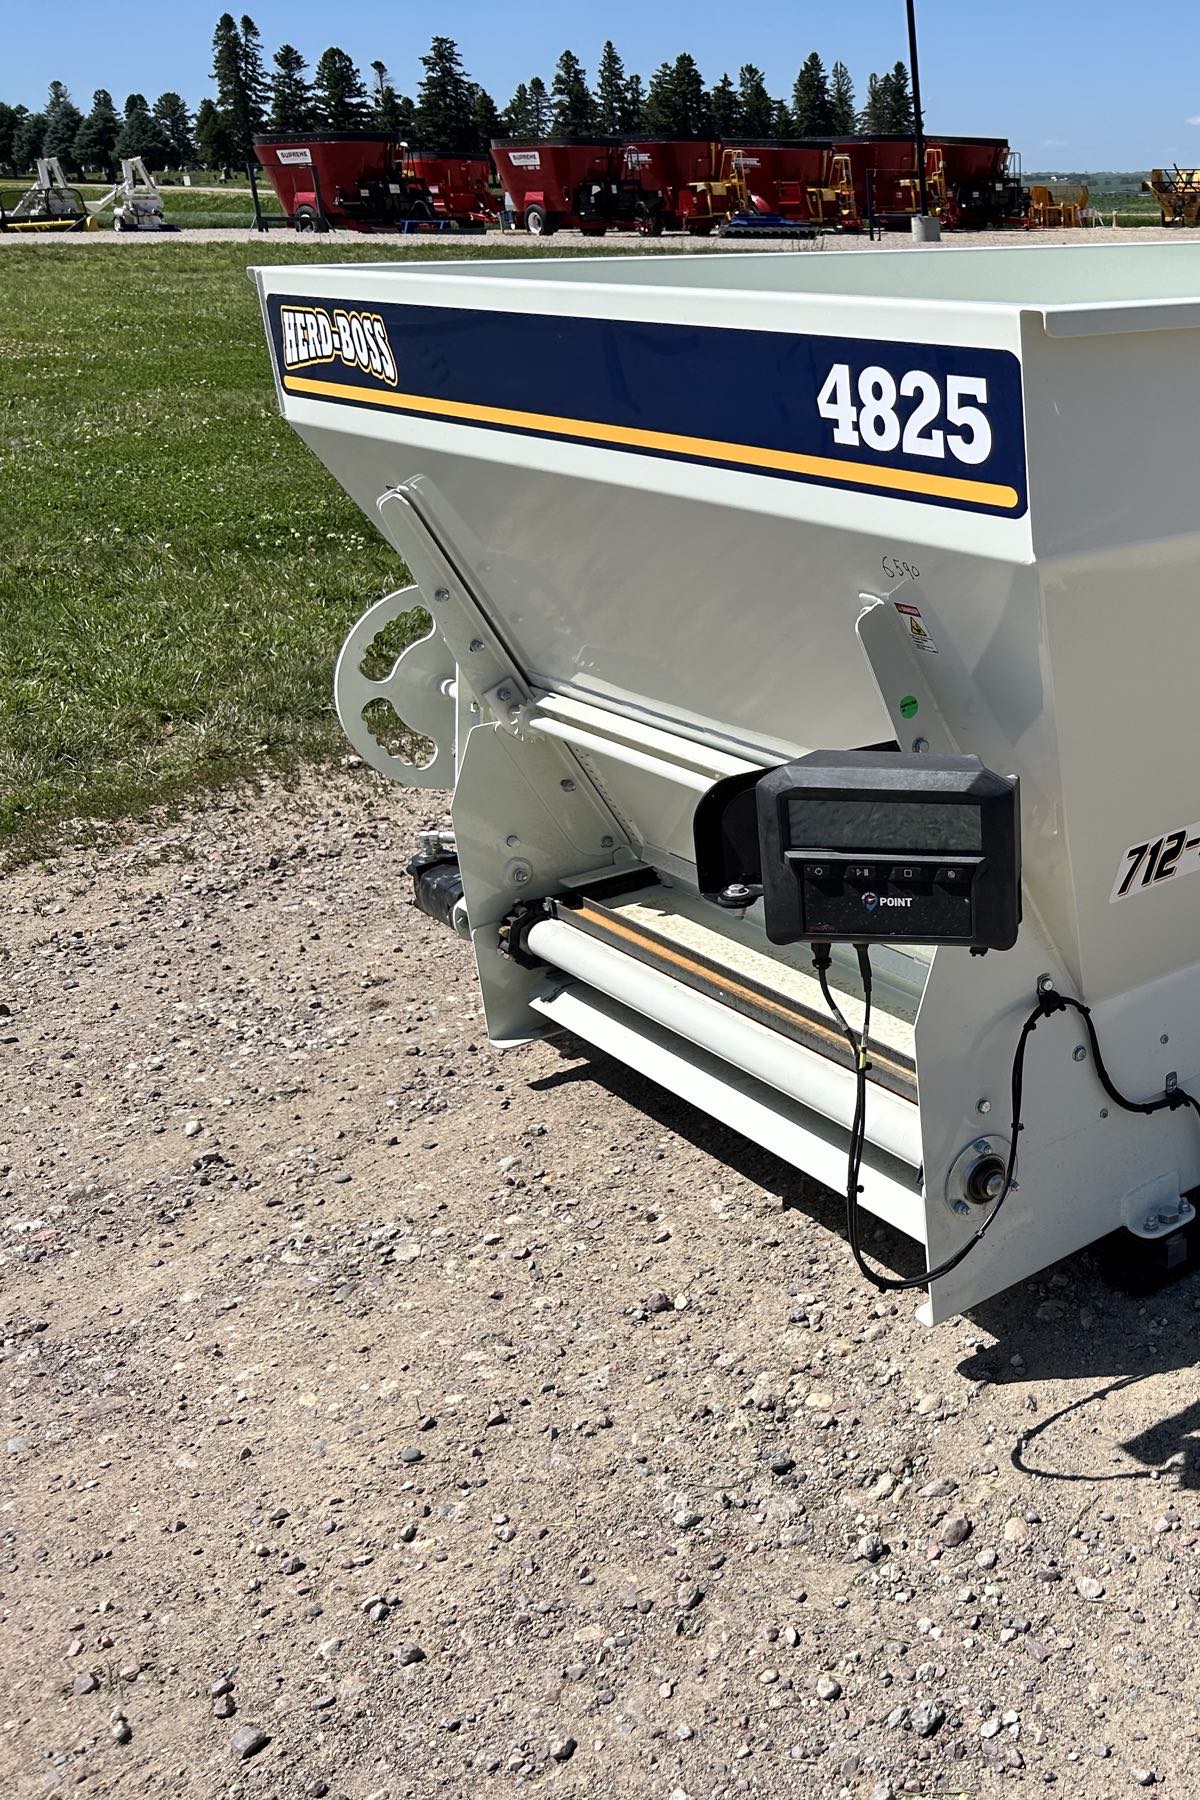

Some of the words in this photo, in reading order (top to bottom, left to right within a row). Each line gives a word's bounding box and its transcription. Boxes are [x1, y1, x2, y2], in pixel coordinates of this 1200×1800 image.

[282, 308, 396, 382] HERD-BOSS
[816, 363, 992, 465] 4825
[881, 555, 920, 580] 6590
[879, 897, 912, 907] POINT
